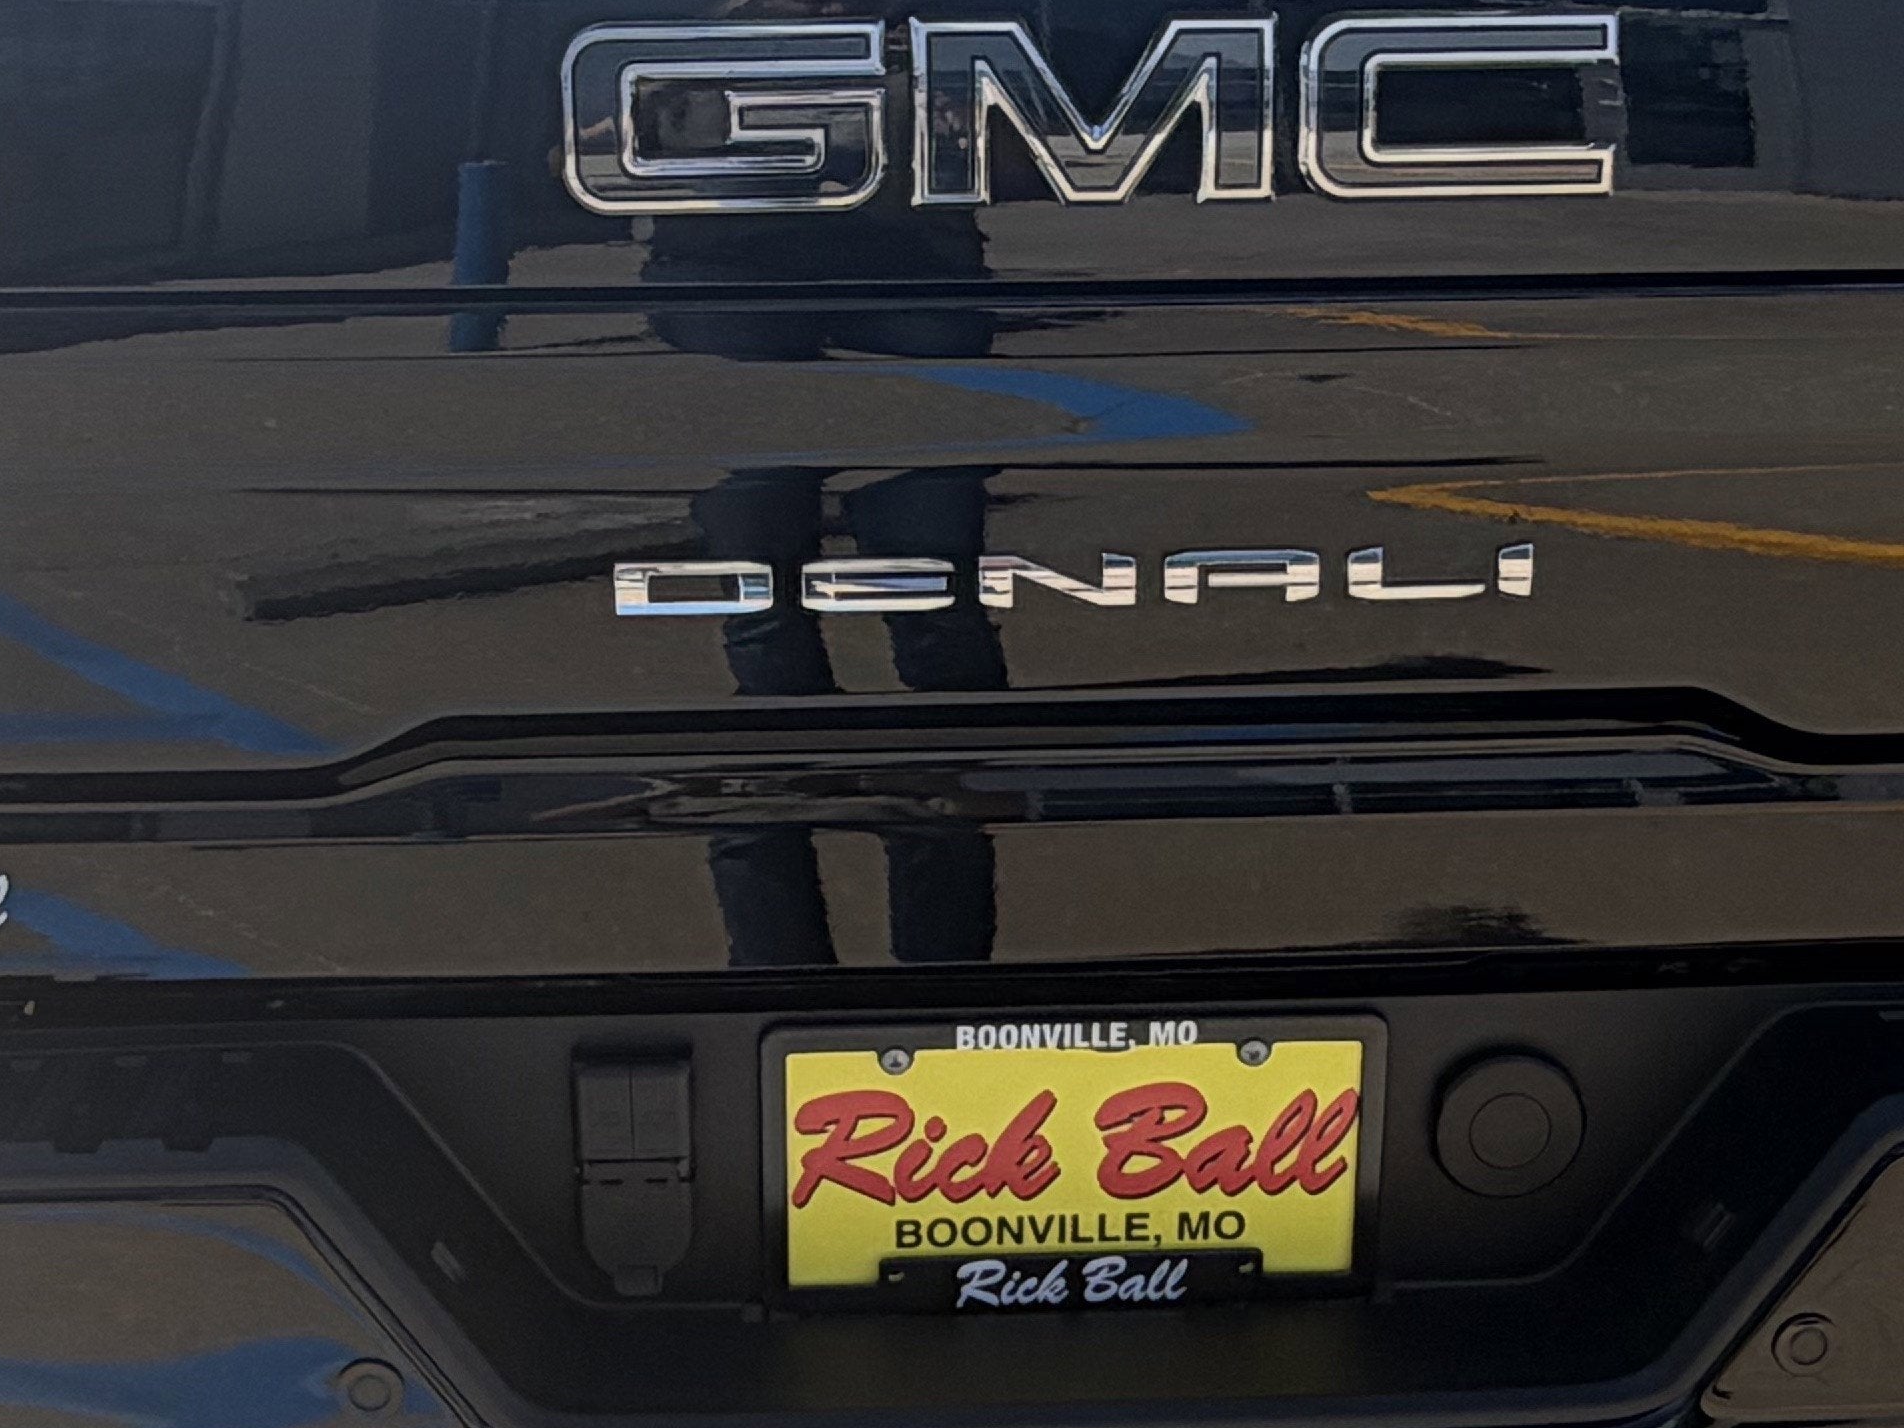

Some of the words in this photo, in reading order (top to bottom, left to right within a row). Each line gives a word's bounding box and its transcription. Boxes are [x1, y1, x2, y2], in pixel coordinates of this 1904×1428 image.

[560, 12, 1620, 216] GMC
[613, 543, 1534, 616] DENALI
[955, 1022, 1137, 1051] BOONVILLE,
[1149, 1020, 1198, 1047] MO
[791, 1089, 1061, 1208] Rick
[1095, 1081, 1360, 1201] Ball
[895, 1212, 1163, 1249] BOONVILLE,
[1177, 1210, 1246, 1241] MO
[955, 1259, 1071, 1309] Rick
[1081, 1257, 1189, 1302] Ball
